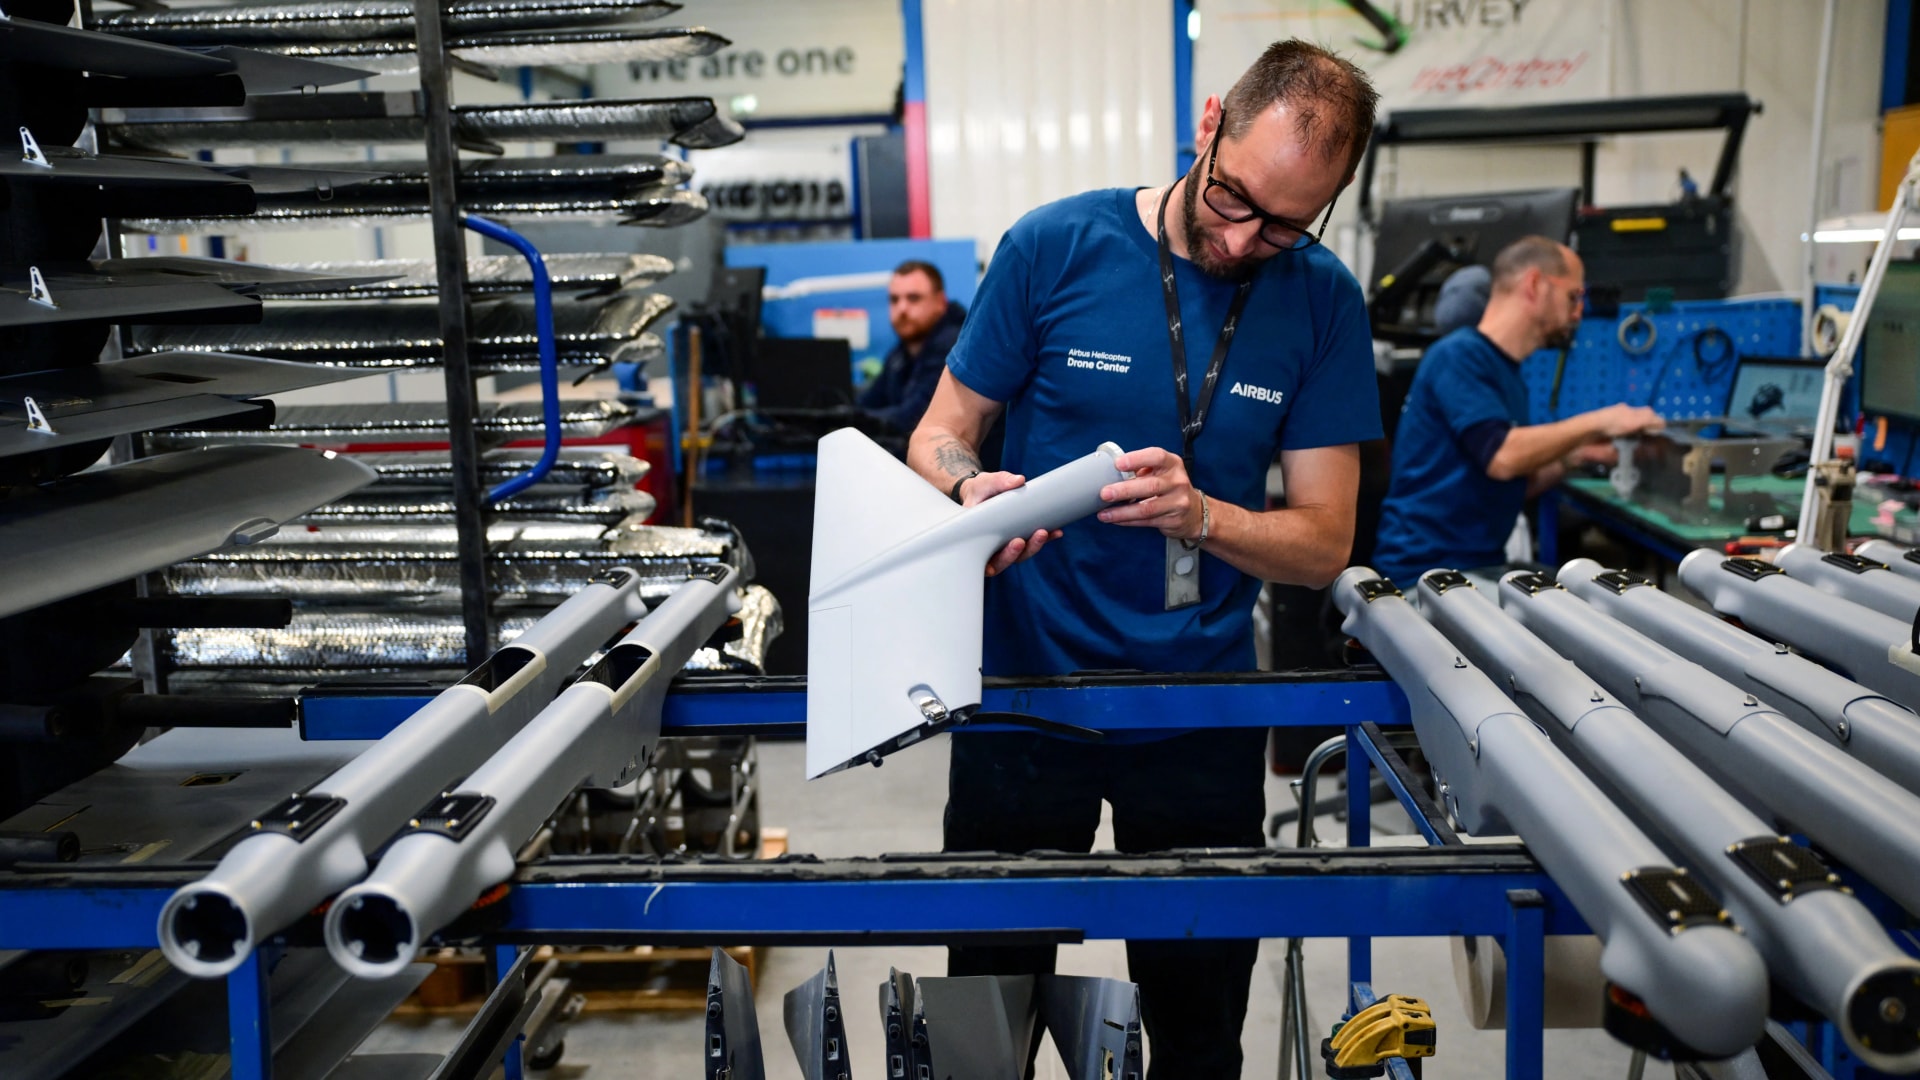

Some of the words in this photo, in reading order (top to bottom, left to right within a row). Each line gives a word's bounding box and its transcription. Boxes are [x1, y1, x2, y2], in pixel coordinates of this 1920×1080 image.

[701, 49, 766, 80] are
[776, 46, 856, 76] one
[1067, 357, 1095, 369] Drone
[1096, 360, 1130, 374] Center
[1068, 348, 1091, 358] Airbus
[1091, 350, 1132, 363] Helicopters
[1230, 381, 1284, 405] AIRBUS
